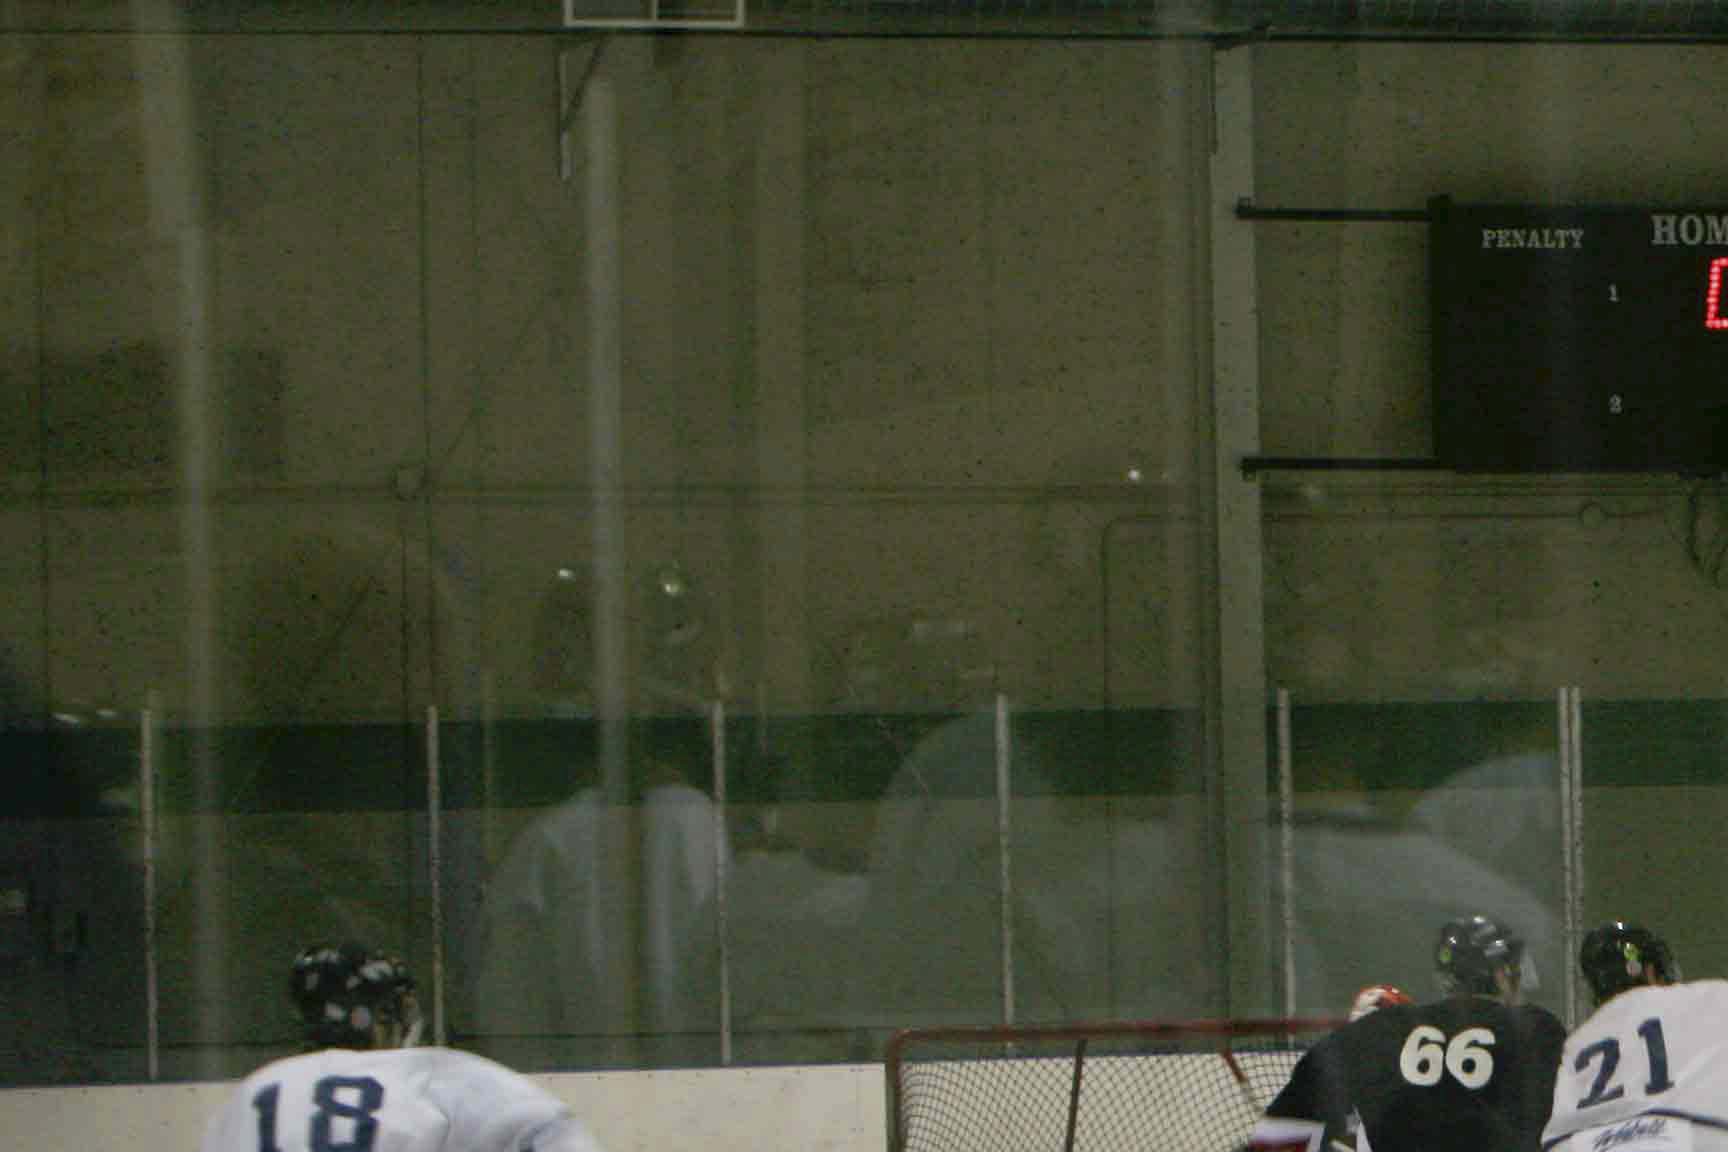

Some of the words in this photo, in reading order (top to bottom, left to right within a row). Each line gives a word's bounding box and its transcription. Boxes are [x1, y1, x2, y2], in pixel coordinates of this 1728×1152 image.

[1481, 228, 1585, 248] PENALTY
[1608, 284, 1620, 302] 1
[1400, 1025, 1496, 1090] 66
[1574, 1016, 1675, 1109] 21
